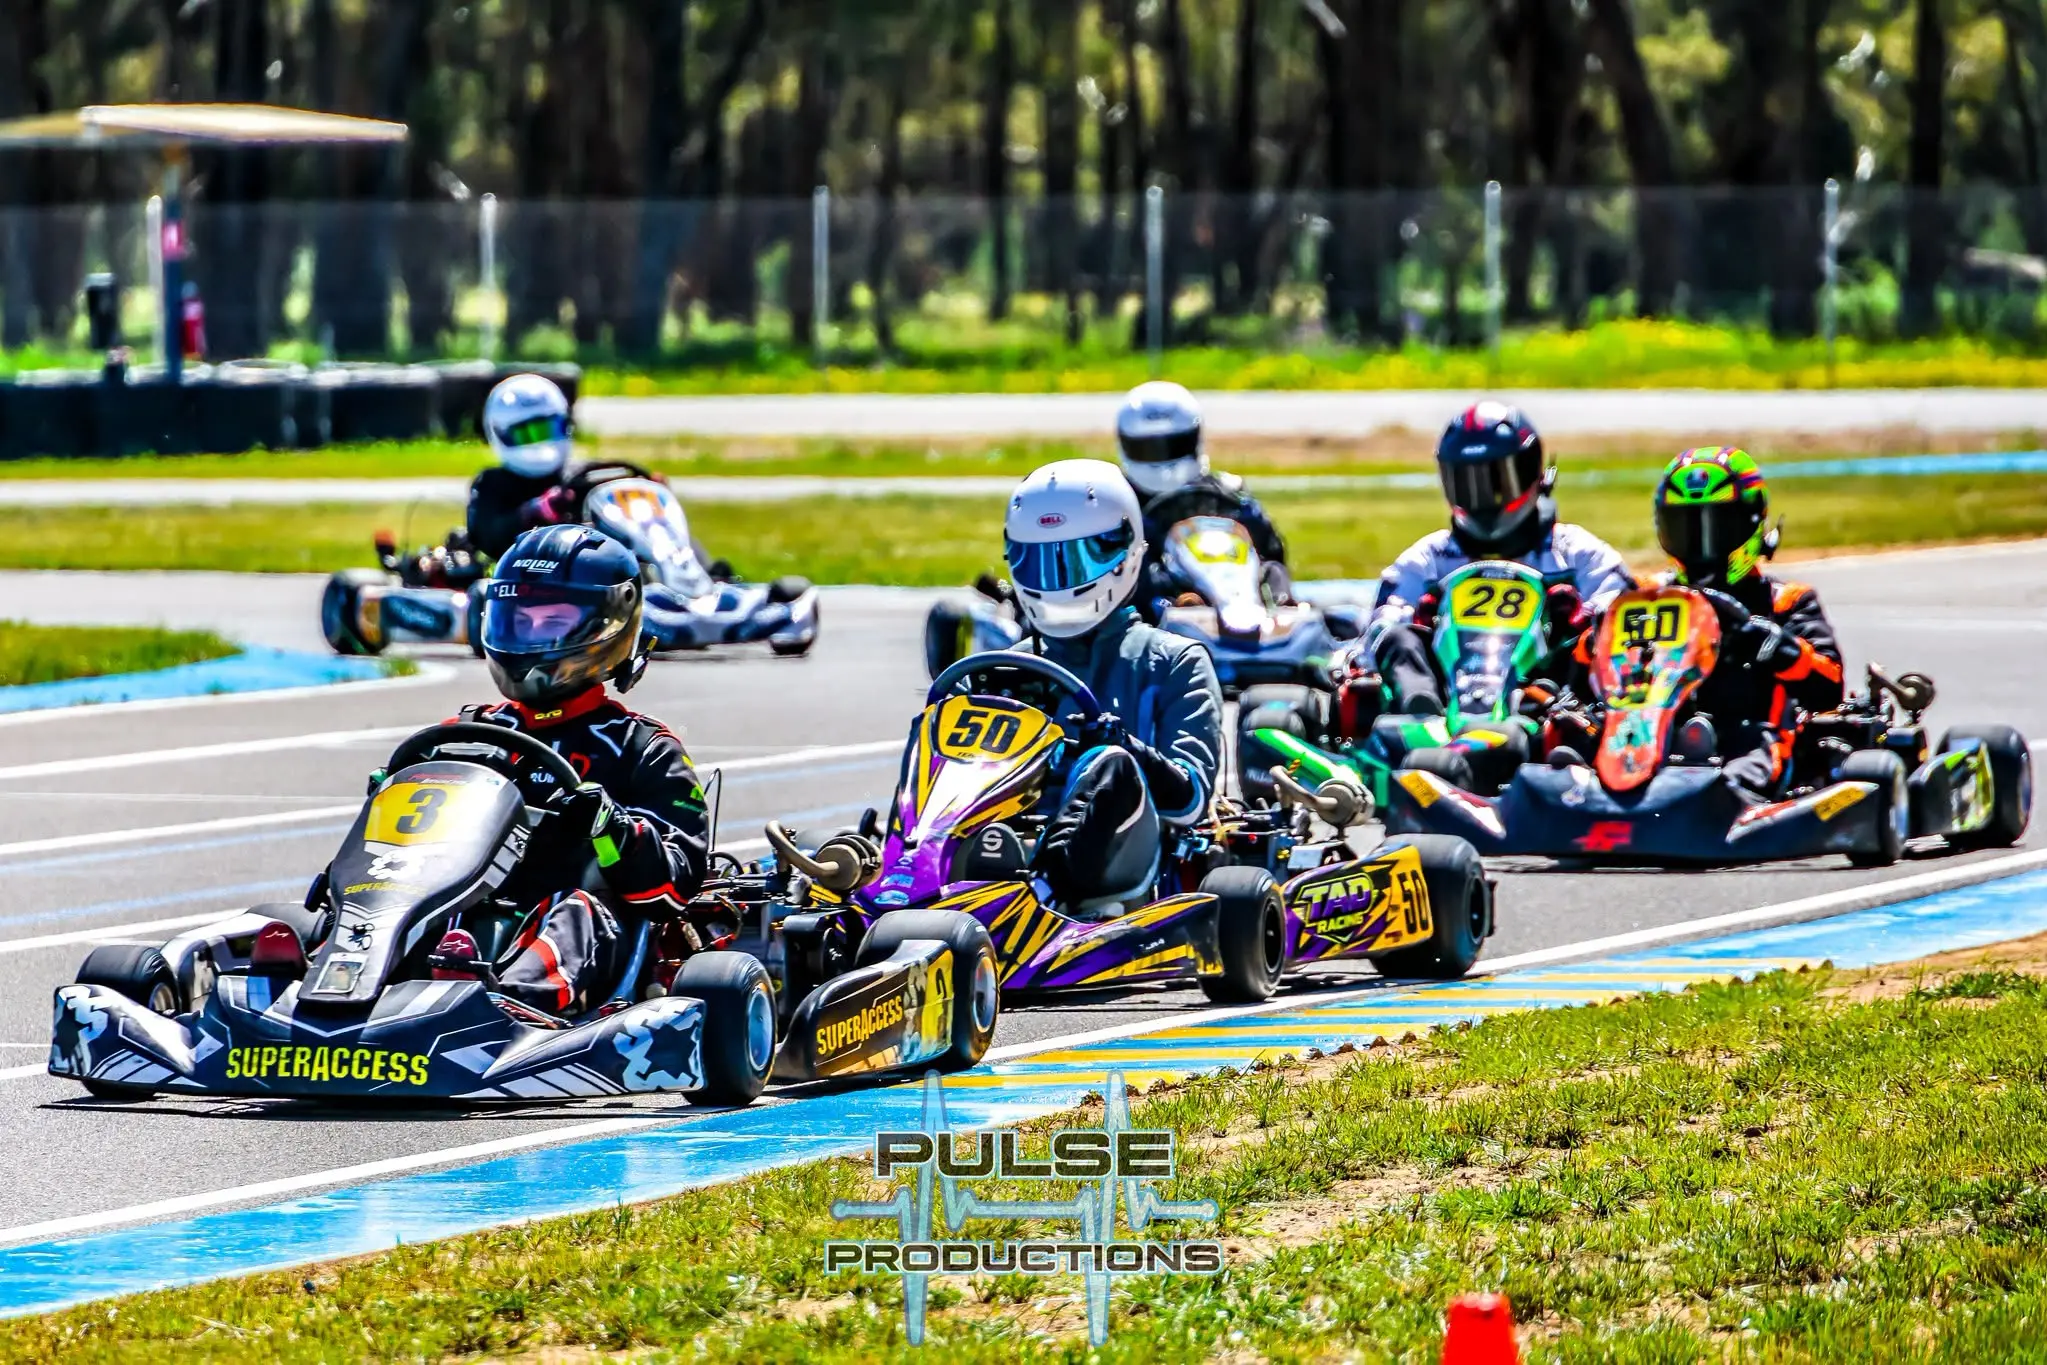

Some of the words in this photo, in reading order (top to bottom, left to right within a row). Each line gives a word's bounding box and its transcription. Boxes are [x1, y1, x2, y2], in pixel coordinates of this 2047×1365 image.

[512, 559, 560, 571] NOLAN
[1462, 585, 1526, 619] 28
[945, 709, 1022, 754] 50
[395, 788, 448, 835] 3
[1301, 876, 1372, 920] TAD
[1397, 869, 1430, 935] 50
[1317, 912, 1365, 934] RACING
[815, 995, 904, 1056] SUPERACCESS
[225, 1046, 430, 1086] SUPERACCESS
